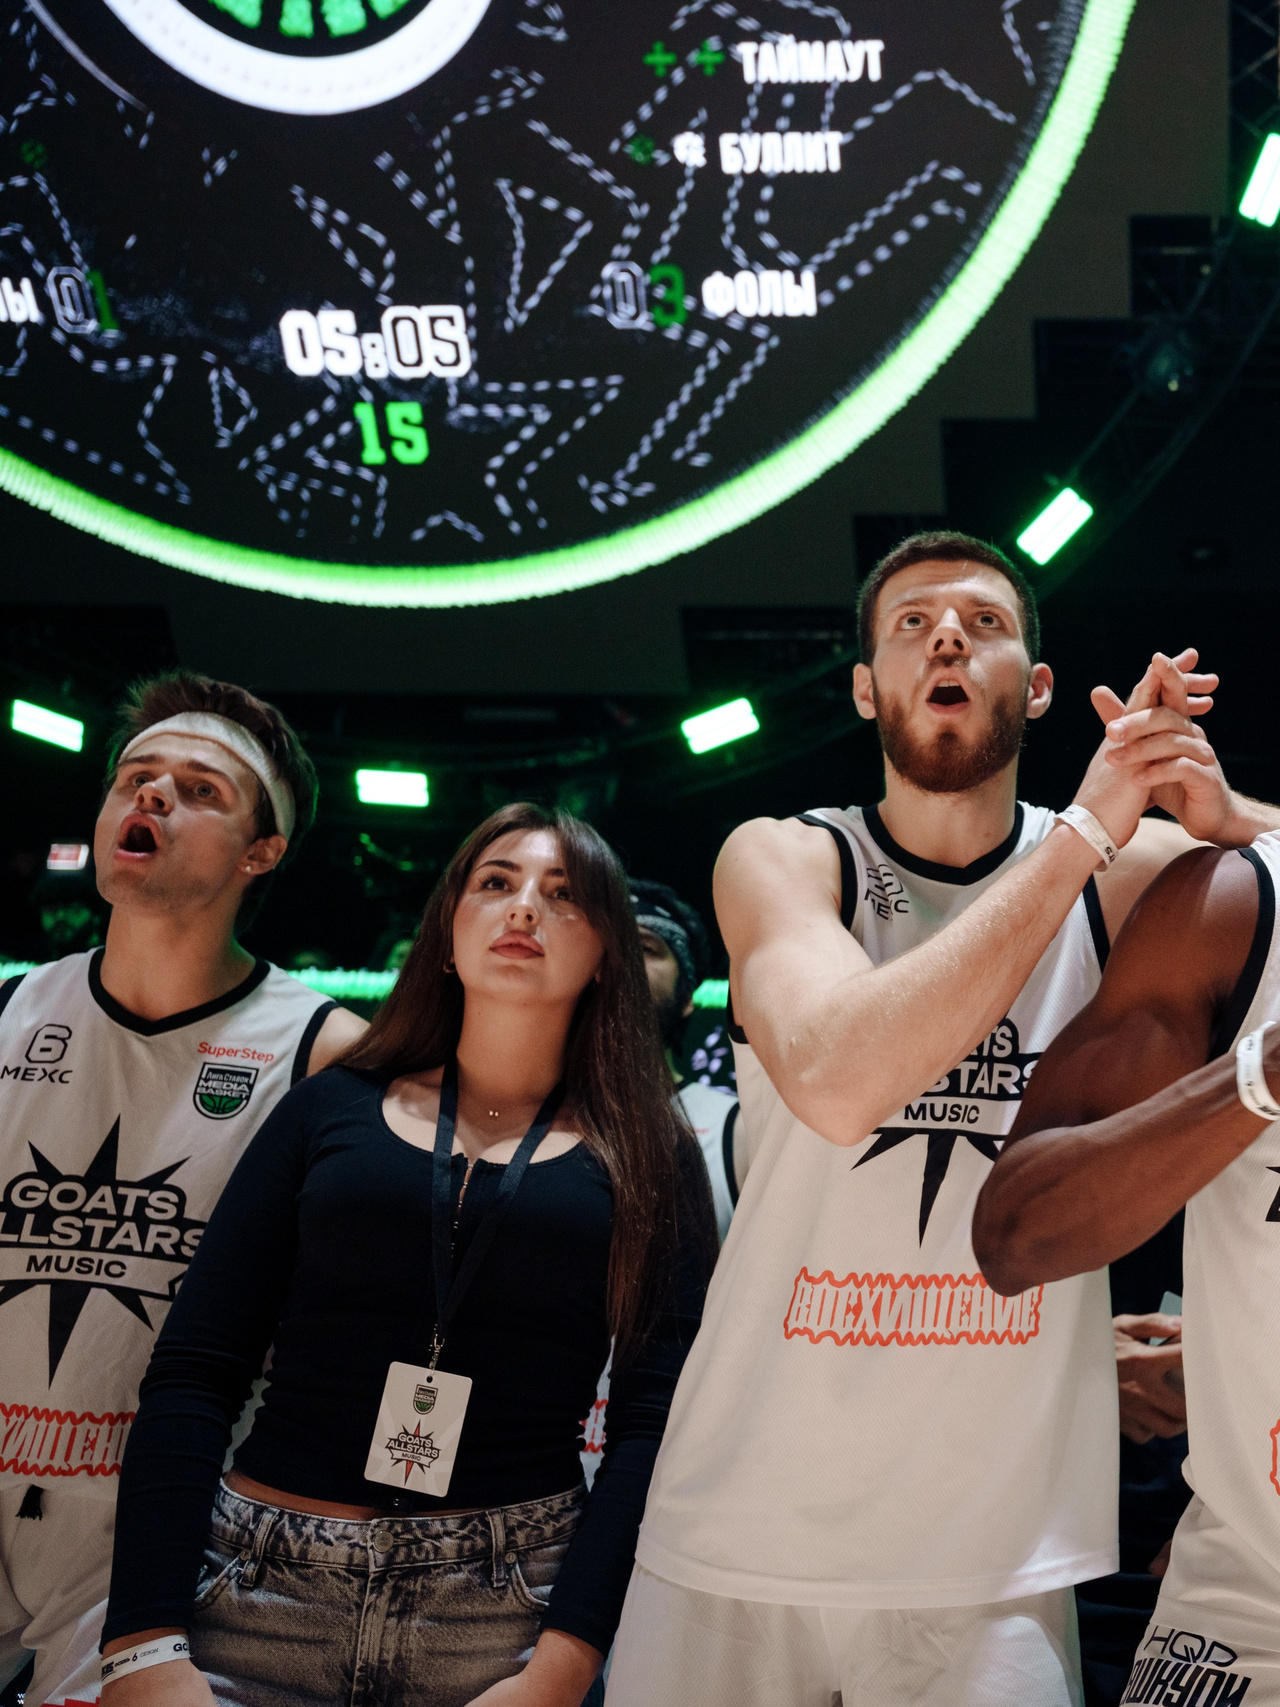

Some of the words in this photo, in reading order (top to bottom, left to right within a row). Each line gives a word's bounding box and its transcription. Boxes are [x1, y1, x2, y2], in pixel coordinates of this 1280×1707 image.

[737, 35, 885, 83] ТАЙМАУТ
[719, 131, 843, 174] БУЛЛИТ
[702, 269, 817, 317] ФОЛЫ
[353, 401, 429, 465] 15
[25, 1024, 73, 1064] 6
[197, 1041, 275, 1063] SuperStep
[0, 1065, 73, 1084] MEXC
[199, 1079, 250, 1093] MEDIA
[904, 1102, 980, 1124] MUSIC
[11, 1178, 180, 1221] GOATS
[0, 1211, 205, 1258] LLSTARS
[25, 1254, 127, 1278] MUSIC
[388, 1440, 439, 1459] ALLSTARS
[399, 1433, 432, 1448] GOATS
[402, 1452, 421, 1461] MUSIC
[1143, 1625, 1238, 1667] HQD
